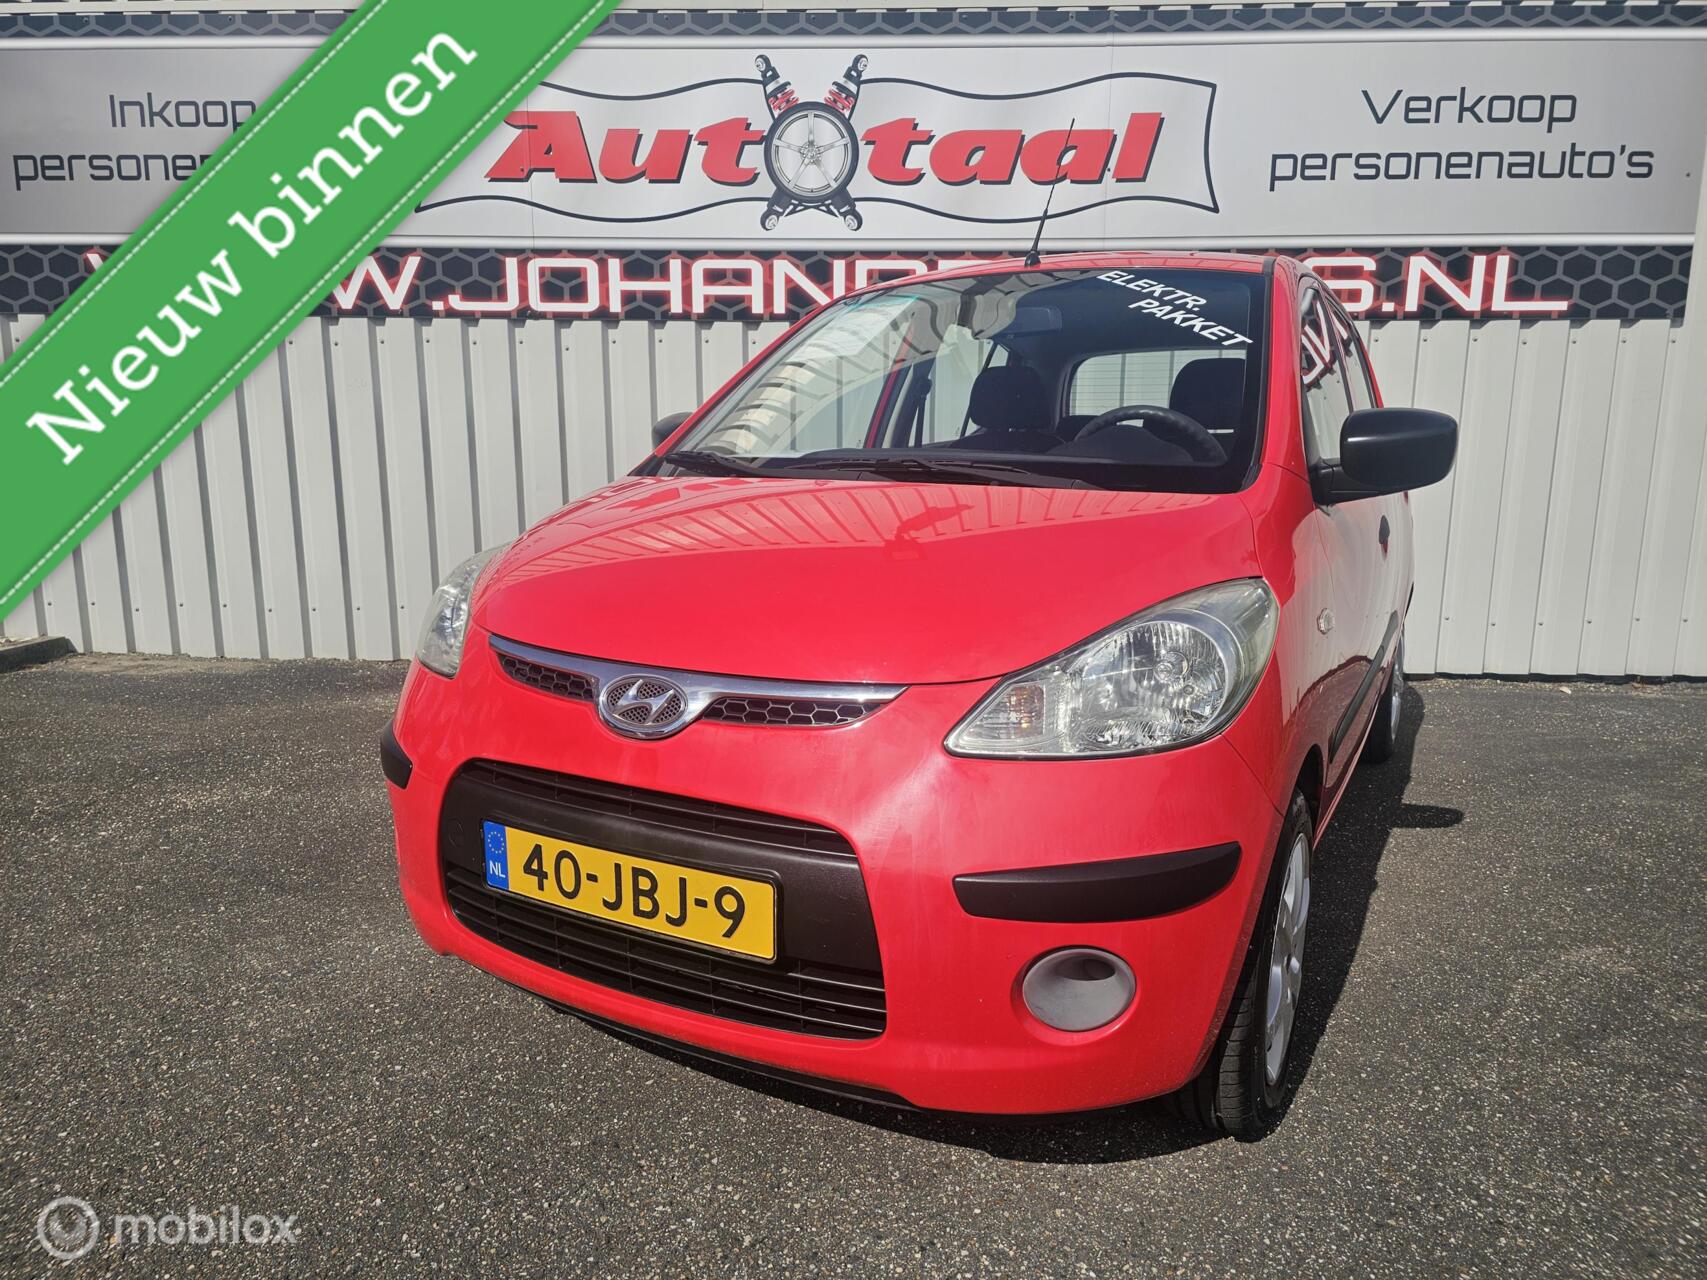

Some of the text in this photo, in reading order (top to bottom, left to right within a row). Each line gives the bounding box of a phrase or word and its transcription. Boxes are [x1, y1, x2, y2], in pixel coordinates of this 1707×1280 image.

[1362, 87, 1577, 133] Verkoop
[13, 154, 213, 191] persone
[1270, 143, 1654, 192] personenauto's
[1096, 270, 1207, 311] ELEKTR.
[1128, 298, 1253, 346] PAKKET
[490, 843, 746, 939] NL 40-JBJ-9
